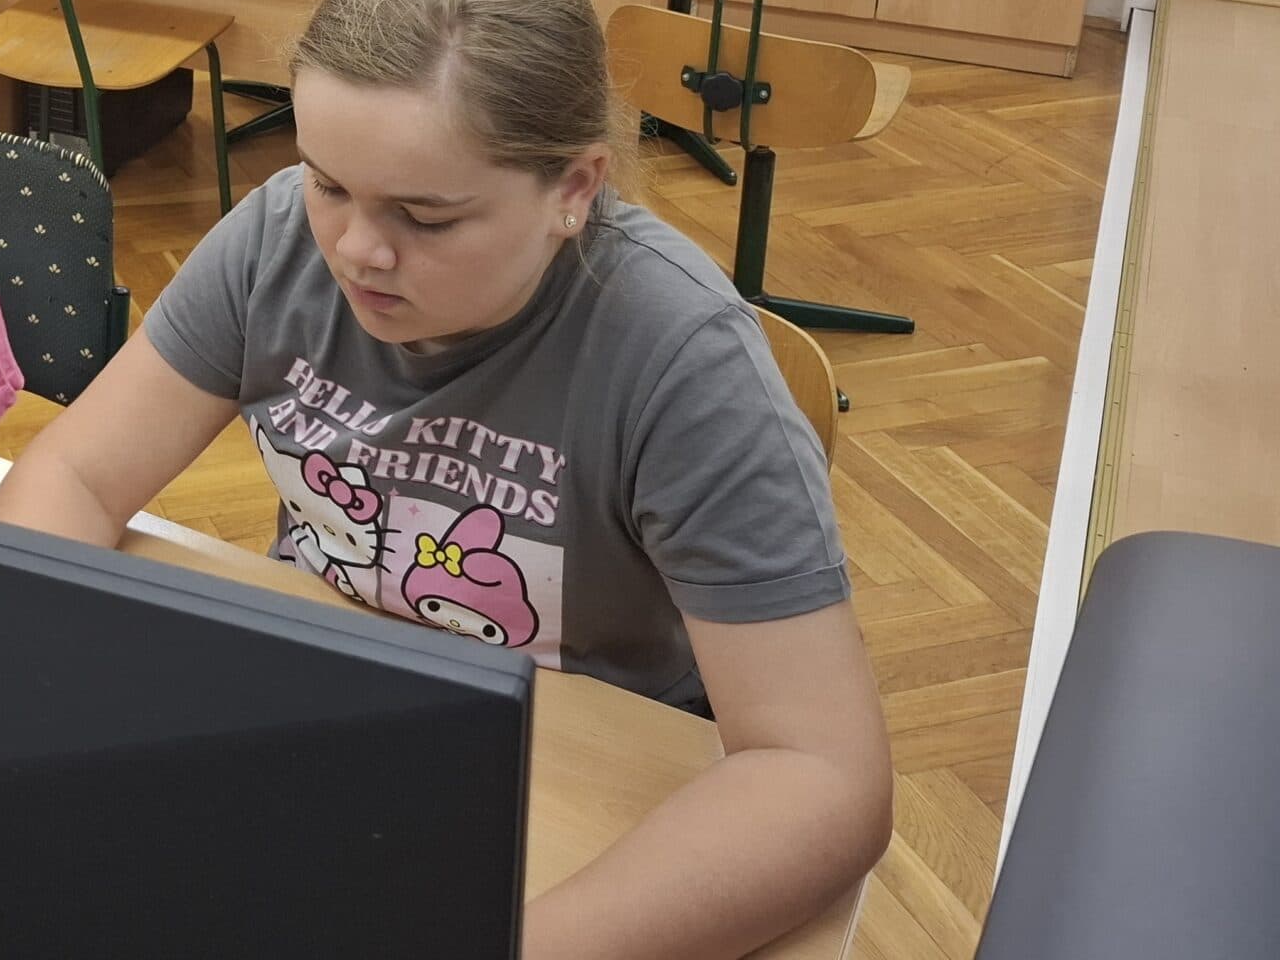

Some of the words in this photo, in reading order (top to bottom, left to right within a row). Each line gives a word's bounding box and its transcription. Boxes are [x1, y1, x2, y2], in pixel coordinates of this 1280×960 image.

[268, 398, 337, 451] AND
[346, 438, 560, 527] FRIENDS
[403, 416, 566, 485] KITTY
